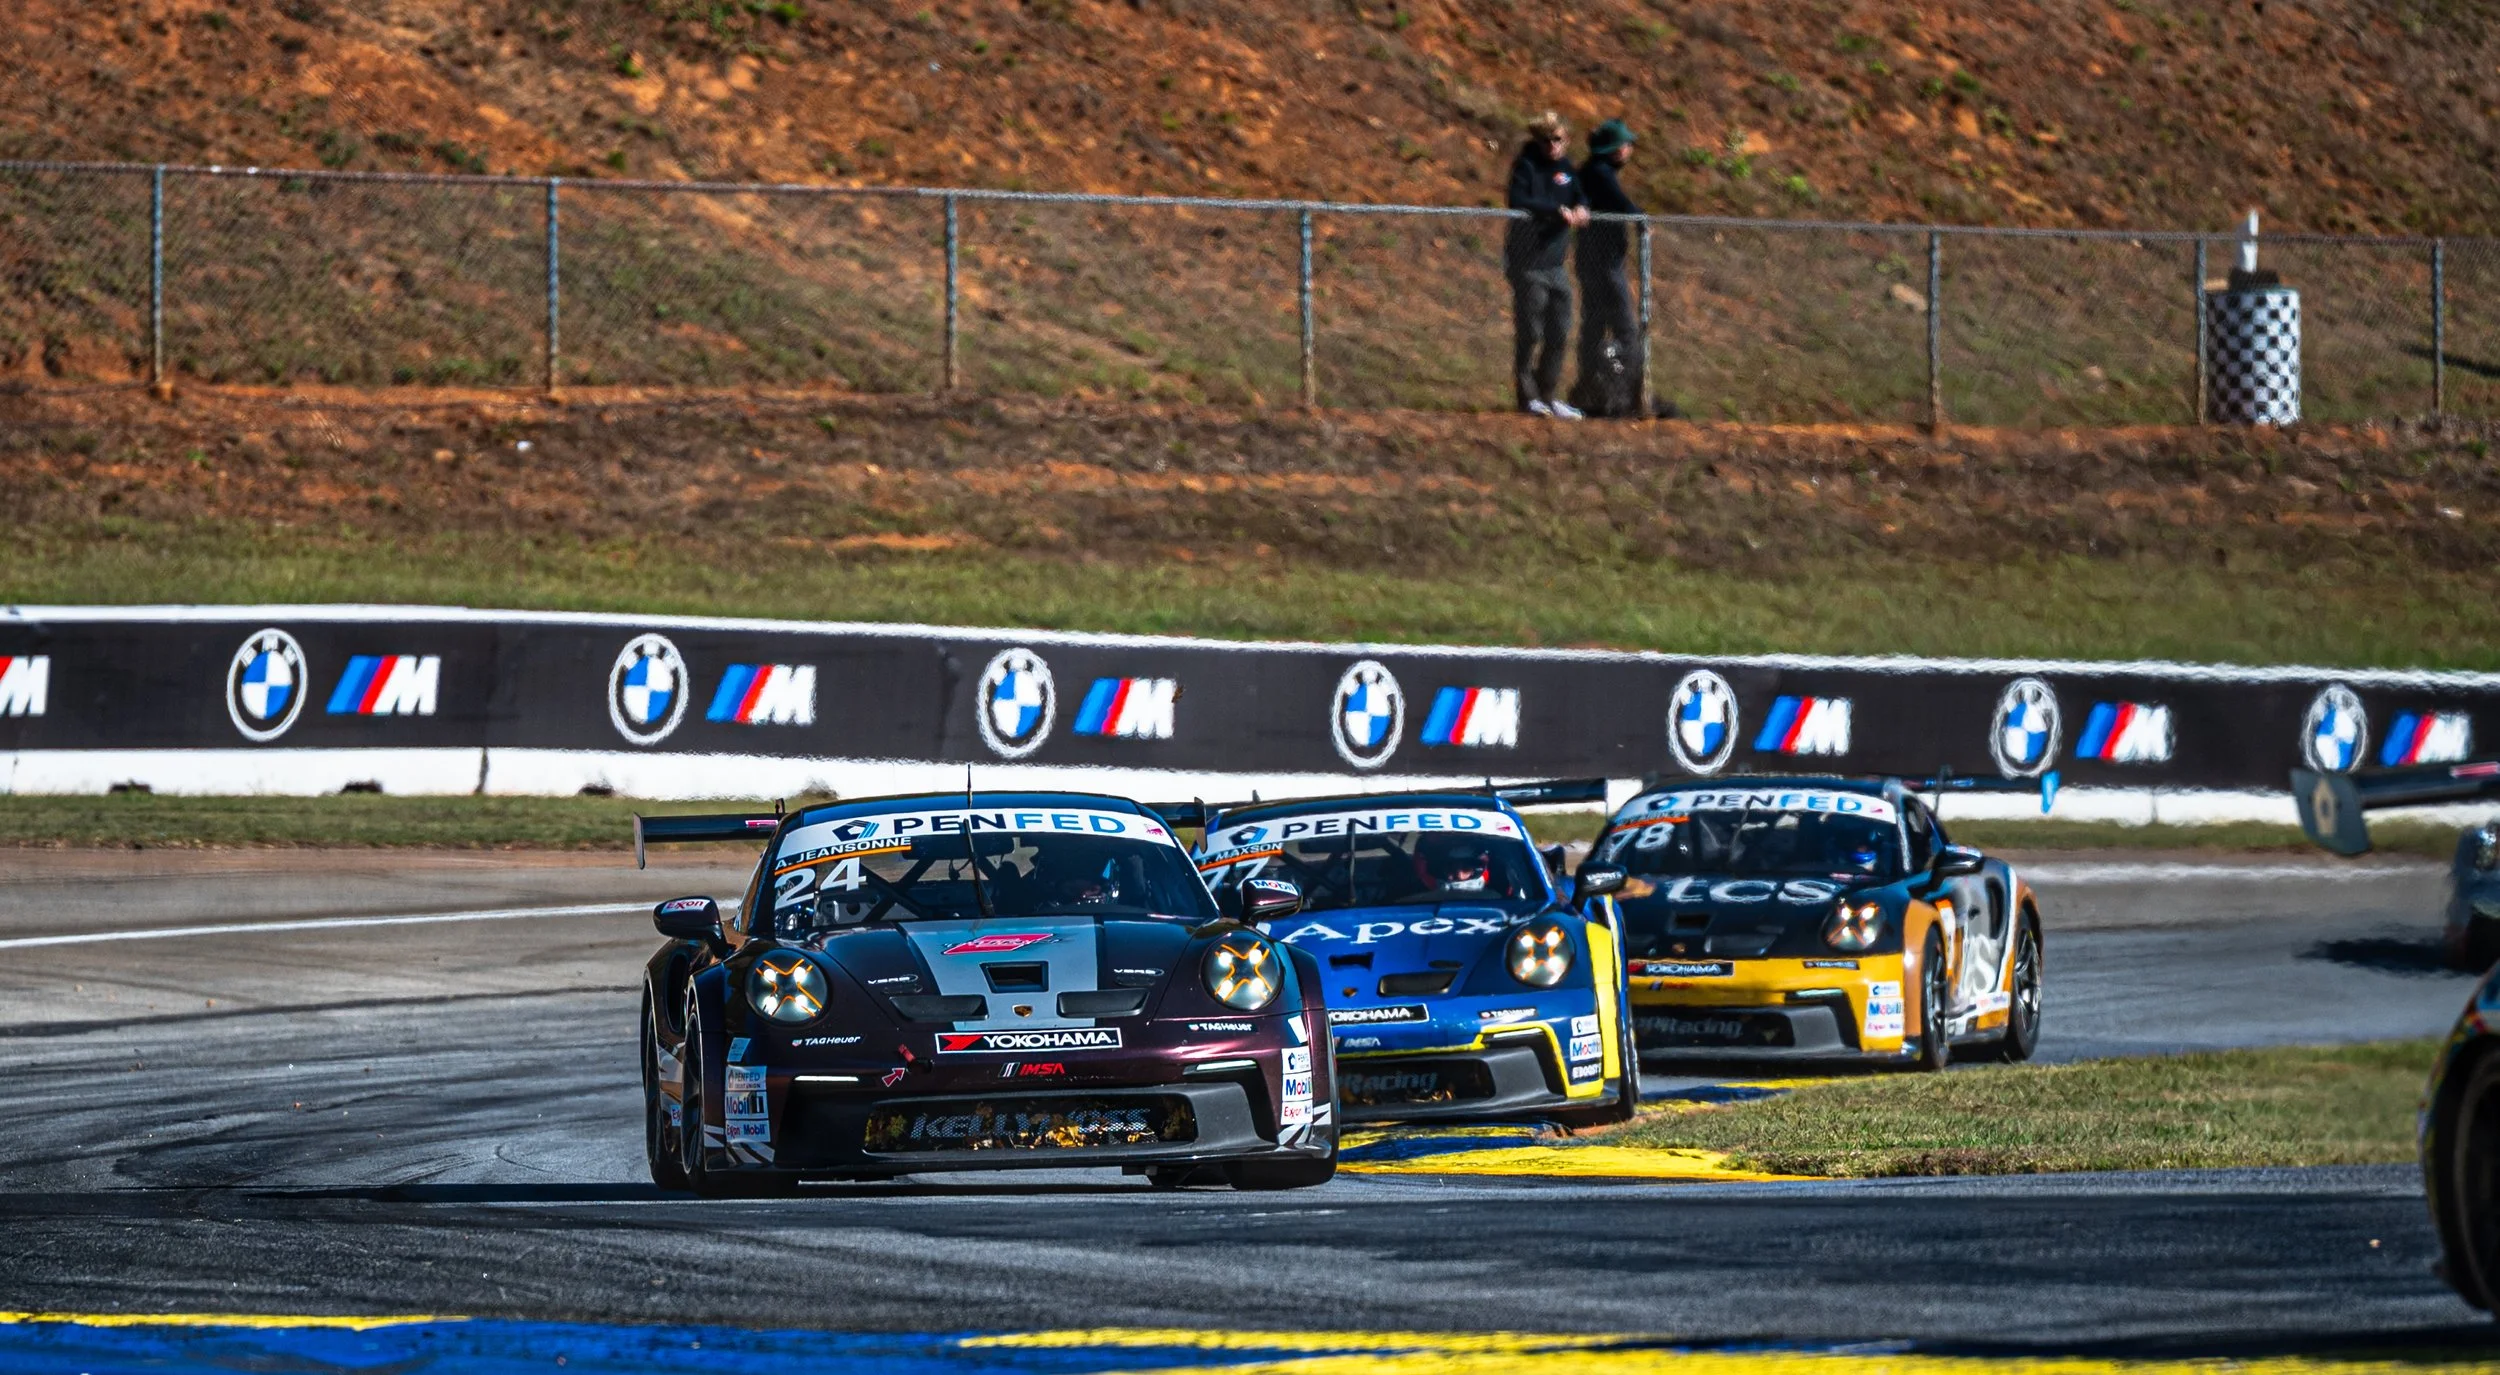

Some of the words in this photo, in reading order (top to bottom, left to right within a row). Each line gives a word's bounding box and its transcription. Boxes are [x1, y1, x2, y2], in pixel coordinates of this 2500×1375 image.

[374, 656, 440, 714] M
[749, 665, 816, 725] M
[1117, 678, 1176, 739] M
[1463, 688, 1520, 748] M
[1796, 698, 1851, 755] M
[1691, 793, 1863, 812] PENFED
[893, 812, 1126, 835] PENFED
[1281, 813, 1482, 839] PENFED
[796, 836, 912, 863] JEANSONNE
[1216, 842, 1284, 862] MAXSON
[1607, 821, 1675, 864] 78
[774, 856, 867, 911] 24
[1253, 880, 1295, 893] Mobil
[1666, 876, 1837, 904] tcs
[666, 901, 704, 910] Exxon
[1280, 917, 1503, 945] Apex
[1646, 963, 1721, 975] YOKOHAMA
[983, 1031, 1112, 1049] YOKOHAMA
[1019, 1062, 1066, 1077] IMSA
[726, 1095, 750, 1115] Mobil
[743, 1123, 766, 1135] Mobil
